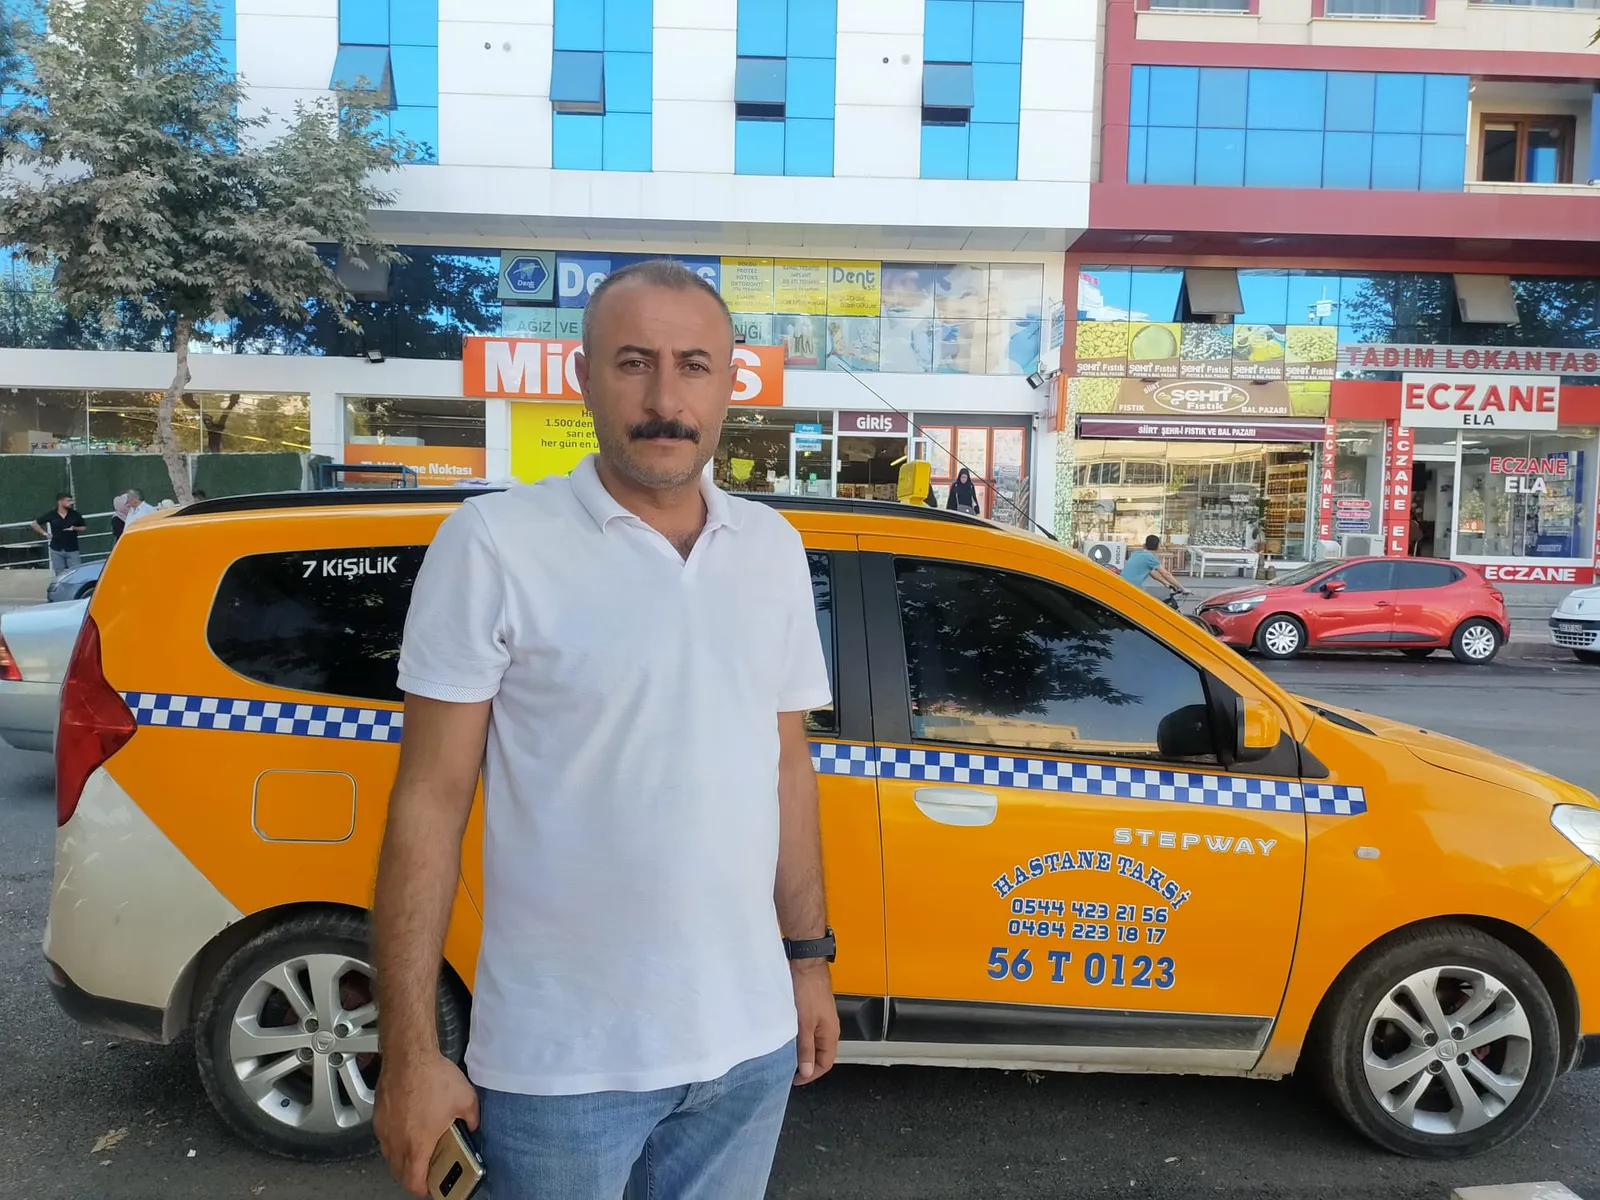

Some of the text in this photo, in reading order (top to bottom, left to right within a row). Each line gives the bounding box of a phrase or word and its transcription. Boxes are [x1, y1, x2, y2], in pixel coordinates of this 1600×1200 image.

[832, 266, 875, 290] Dent
[560, 322, 578, 334] VE
[1346, 346, 1434, 368] TADIM
[1405, 382, 1556, 412] ECZANE
[546, 418, 593, 427] 1.500'den
[856, 415, 892, 432] GİRİŞ
[1185, 427, 1206, 435] FISTIK
[1463, 414, 1495, 426] ELA
[541, 439, 557, 447] her
[559, 441, 577, 450] gün
[429, 463, 472, 475] Noktası
[1322, 425, 1334, 508] ECZANE
[1384, 427, 1392, 510] ECZANE
[1394, 427, 1410, 510] ECZANE
[1489, 457, 1568, 474] ECZANE
[1505, 476, 1548, 494] ELA
[302, 556, 398, 580] 7 KİŞİLİK
[1485, 566, 1576, 582] ECZANE
[1113, 827, 1278, 856] STEPWAY
[992, 850, 1192, 910] HASTANE TAKSİ
[1010, 898, 1169, 924] 0544 423 21 56
[1008, 918, 1167, 944] 0484 223 18 17
[986, 946, 1176, 990] 56 T 0123
